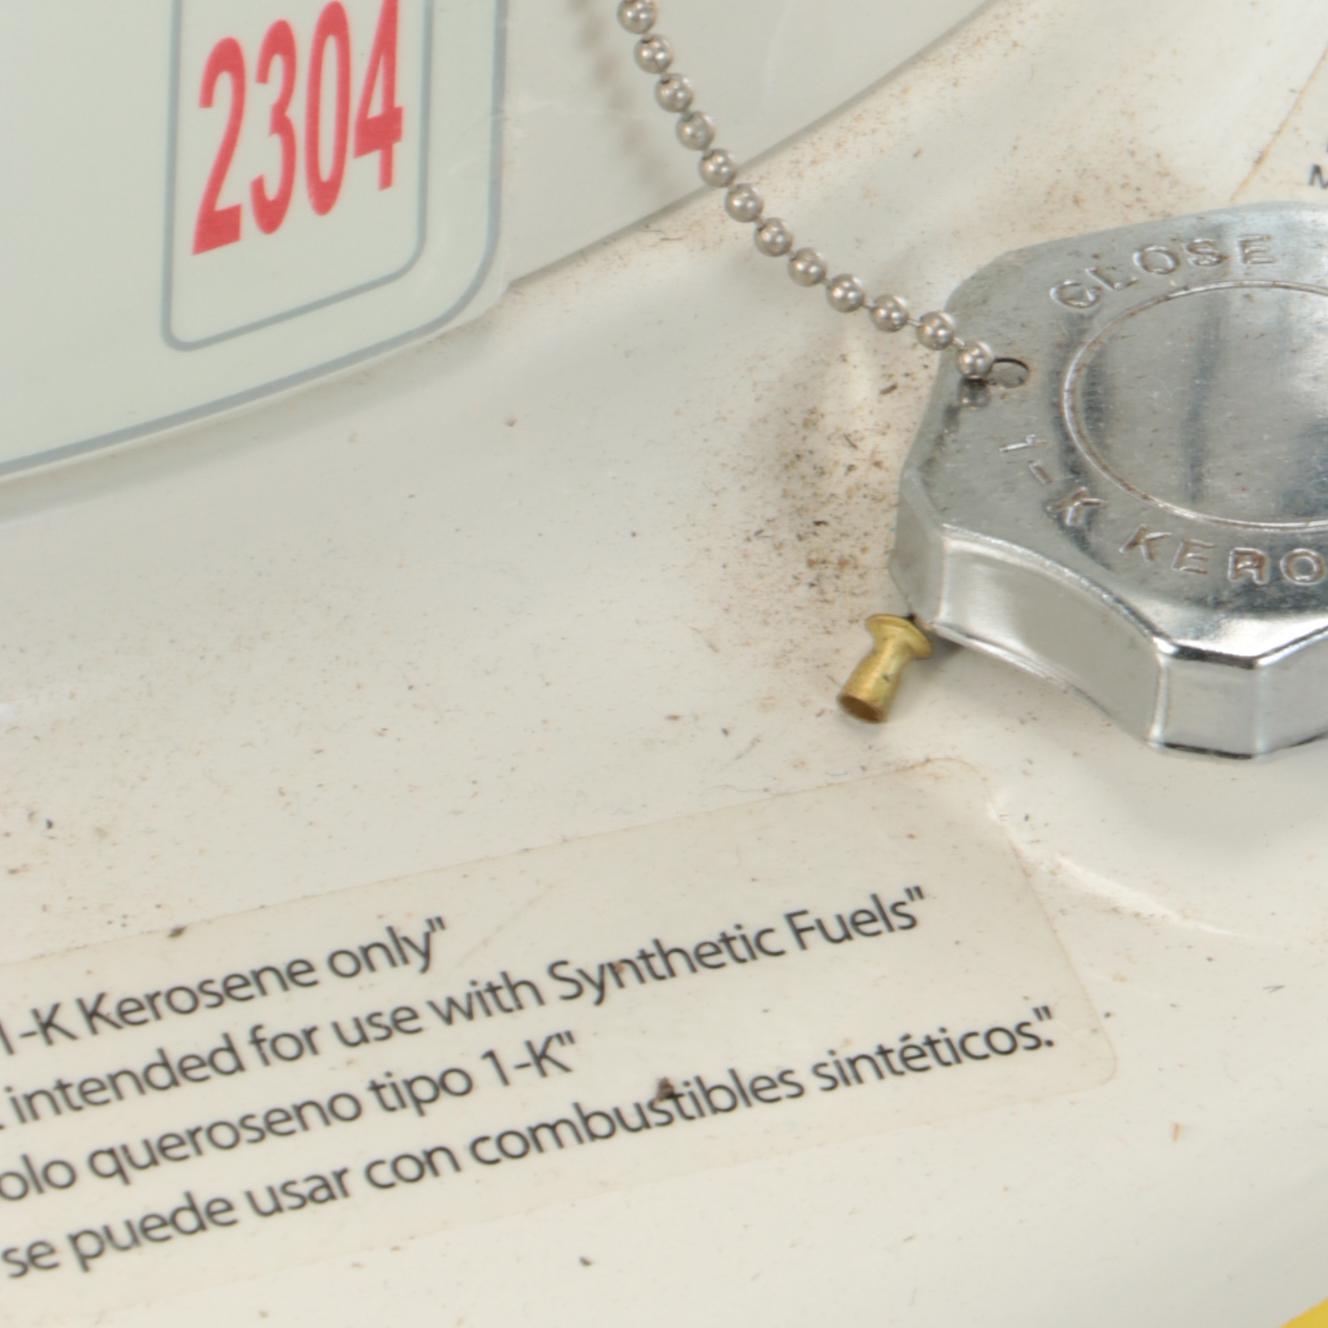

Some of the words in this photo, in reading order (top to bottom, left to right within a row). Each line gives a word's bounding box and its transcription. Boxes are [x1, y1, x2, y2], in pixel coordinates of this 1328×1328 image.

[1050, 234, 1280, 313] CLOSE
[4, 1032, 246, 1125] intended
[248, 1023, 322, 1068] for
[330, 1004, 425, 1048] use
[426, 970, 546, 1027] with
[546, 922, 786, 1007] Synthetic
[783, 884, 926, 951] Fuels"
[75, 955, 321, 1036] Kerosene
[326, 915, 447, 974] only"
[0, 1238, 61, 1279] se
[66, 1189, 239, 1274] puede
[243, 1166, 356, 1219] usar
[363, 1142, 463, 1190] con
[468, 1068, 806, 1166] combustibles
[86, 1090, 364, 1186] queroseno
[368, 1065, 475, 1117] tipo
[480, 1029, 578, 1088] 1-K"
